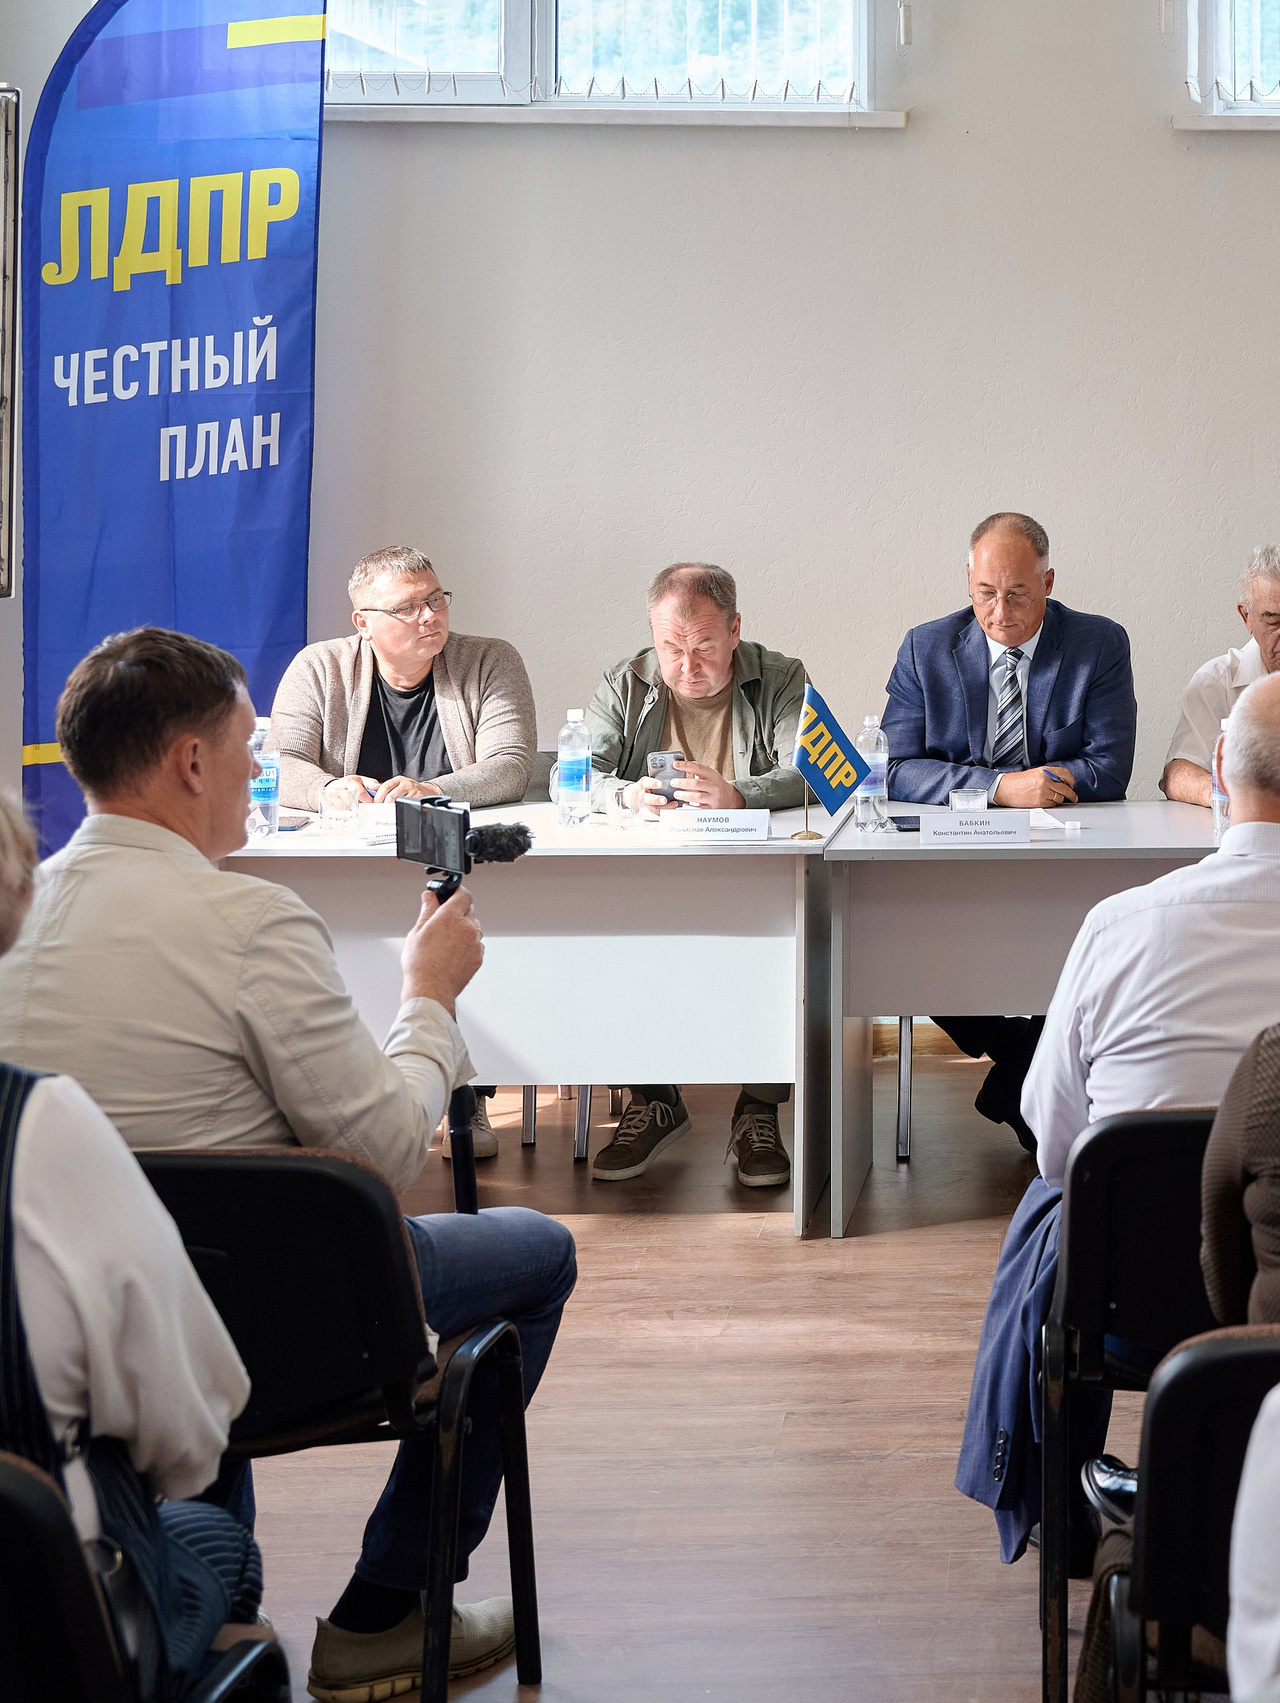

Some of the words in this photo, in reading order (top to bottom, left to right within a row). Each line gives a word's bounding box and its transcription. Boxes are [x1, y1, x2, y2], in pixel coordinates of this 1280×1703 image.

[41, 167, 300, 292] ЛДПР
[53, 314, 278, 407] ЧЕСТНЫЙ
[159, 412, 281, 482] ПЛАН
[704, 826, 757, 834] Александрович
